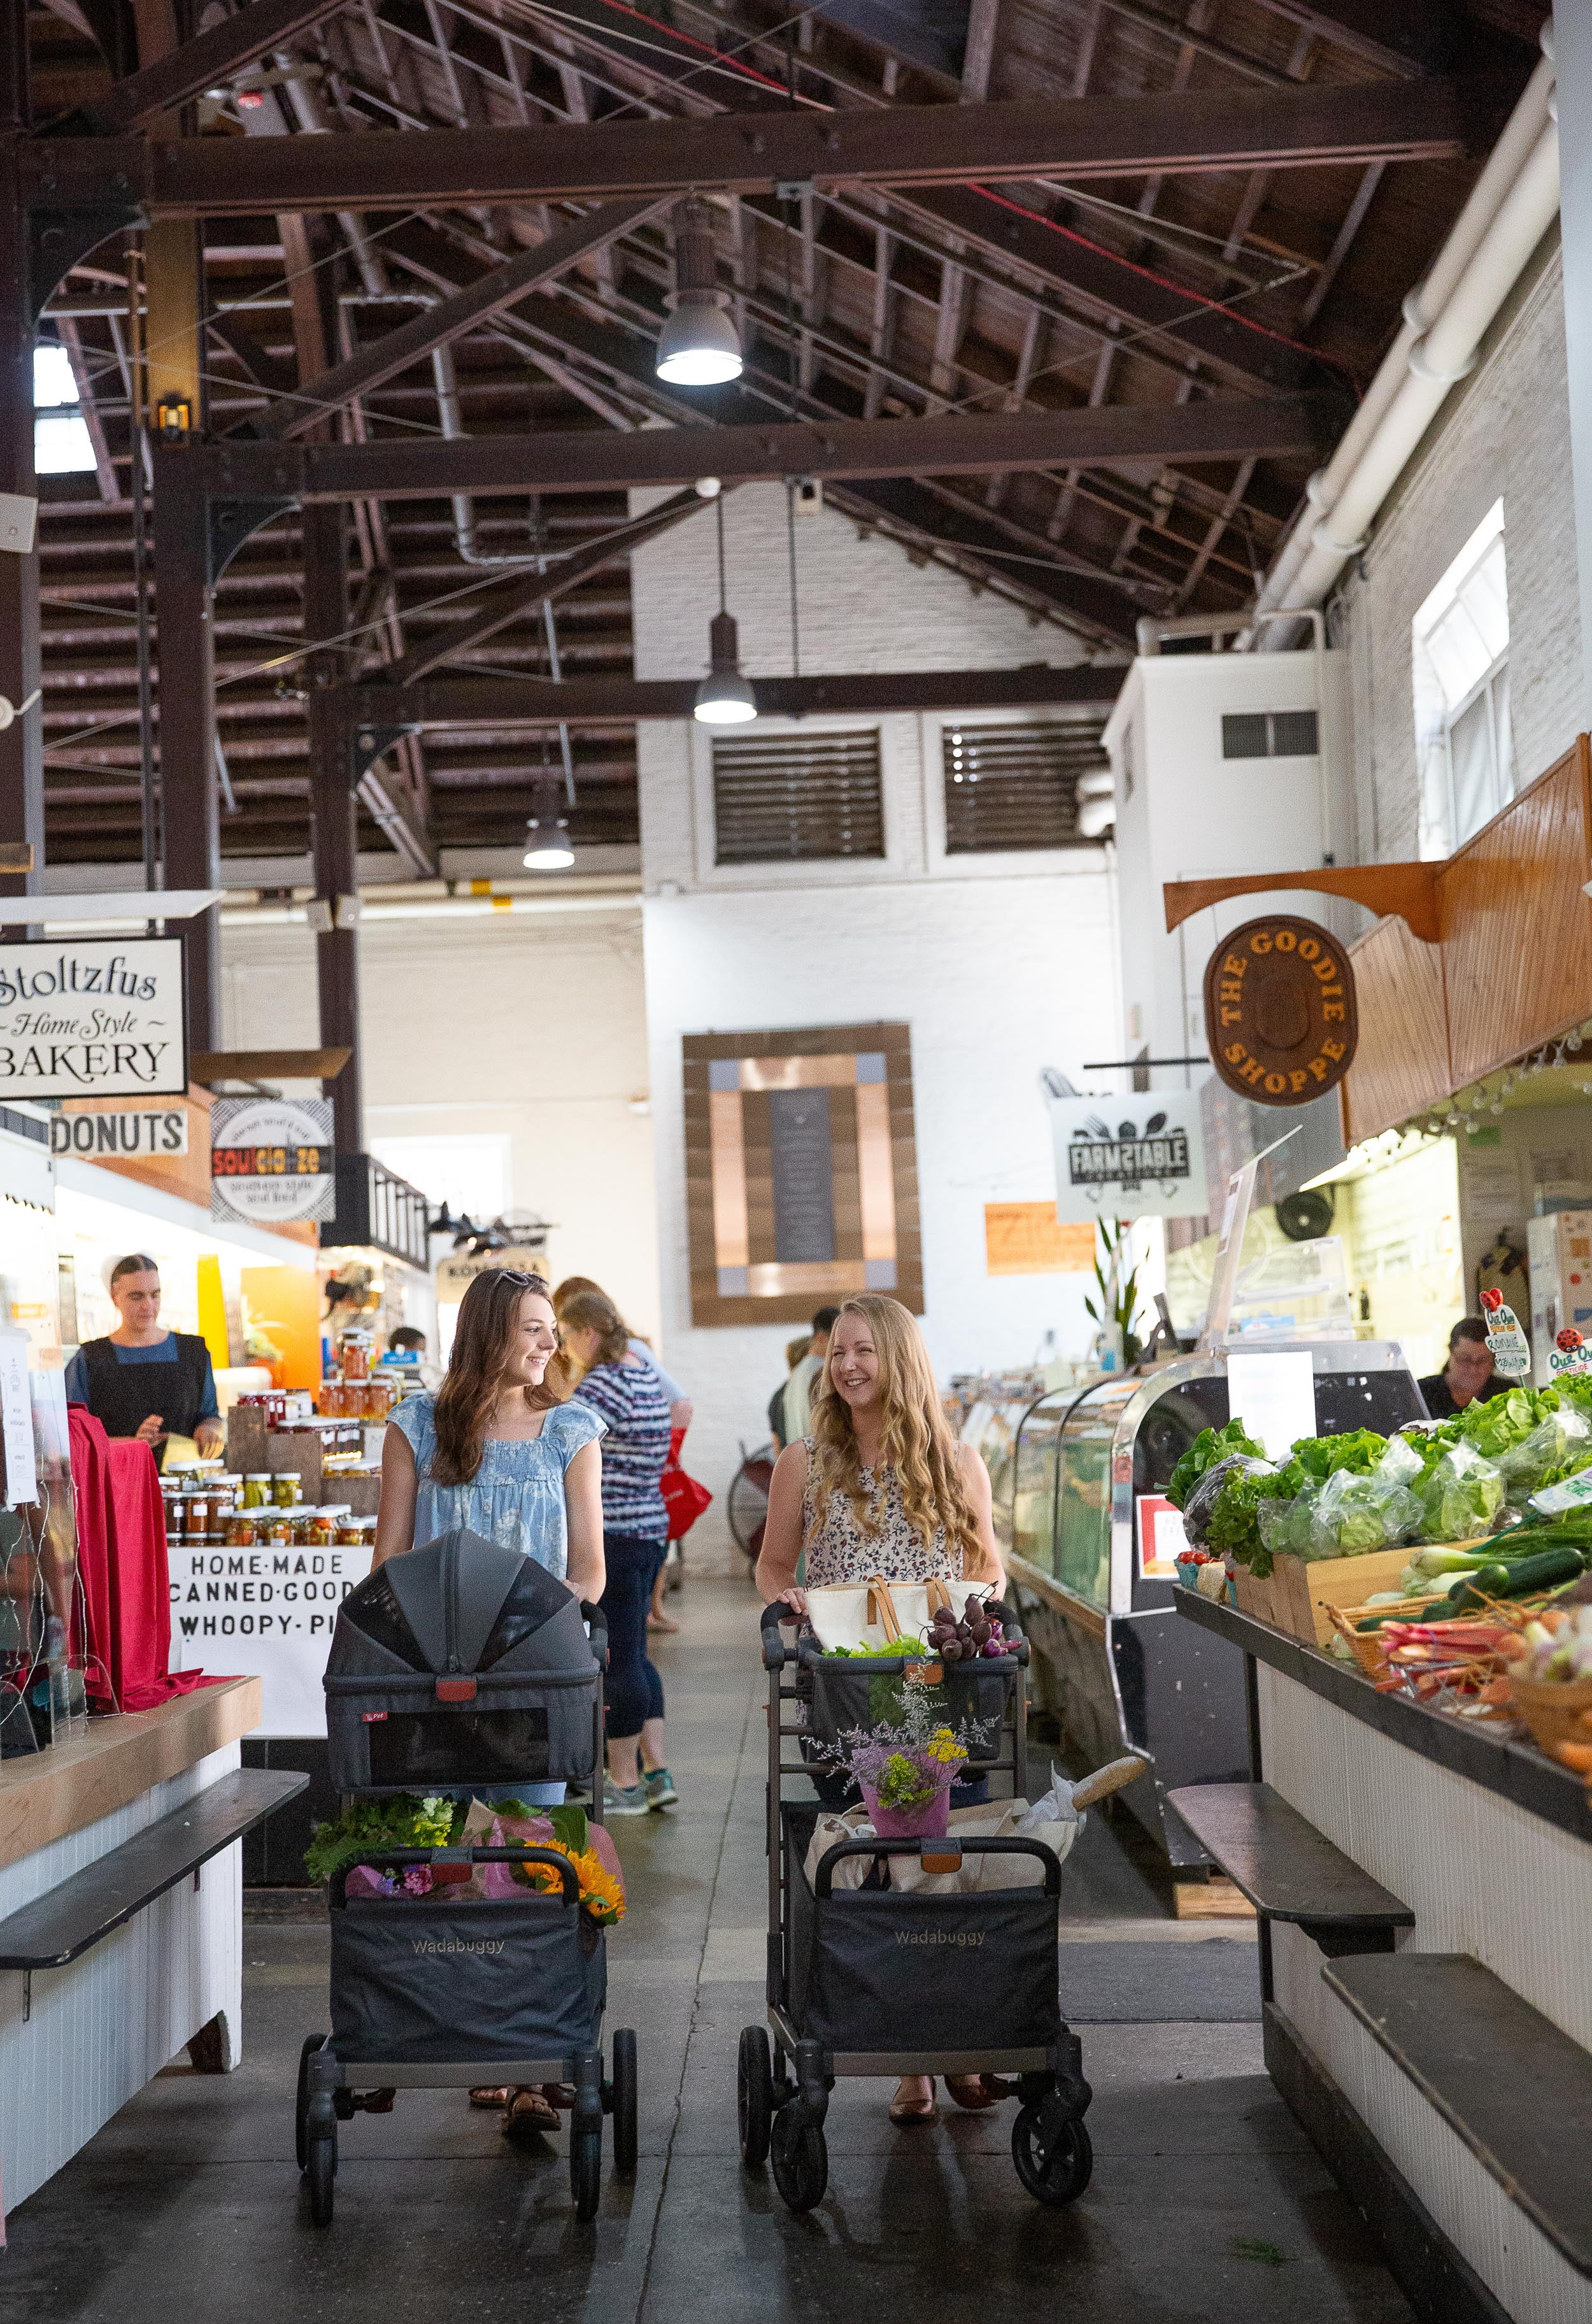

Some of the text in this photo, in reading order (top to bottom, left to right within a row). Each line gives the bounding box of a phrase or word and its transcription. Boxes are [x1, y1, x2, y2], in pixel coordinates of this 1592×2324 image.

[0, 954, 157, 1006] Stoltzfus
[1220, 930, 1345, 1027] THE GOODIE
[11, 1008, 138, 1041] Home Style
[0, 1042, 169, 1084] BAKERY
[1225, 1037, 1346, 1094] SHOPPE
[50, 1113, 183, 1153] DONUTS
[412, 1937, 504, 1955] Wadabuggy
[895, 1928, 986, 1946] Wadabuggy
